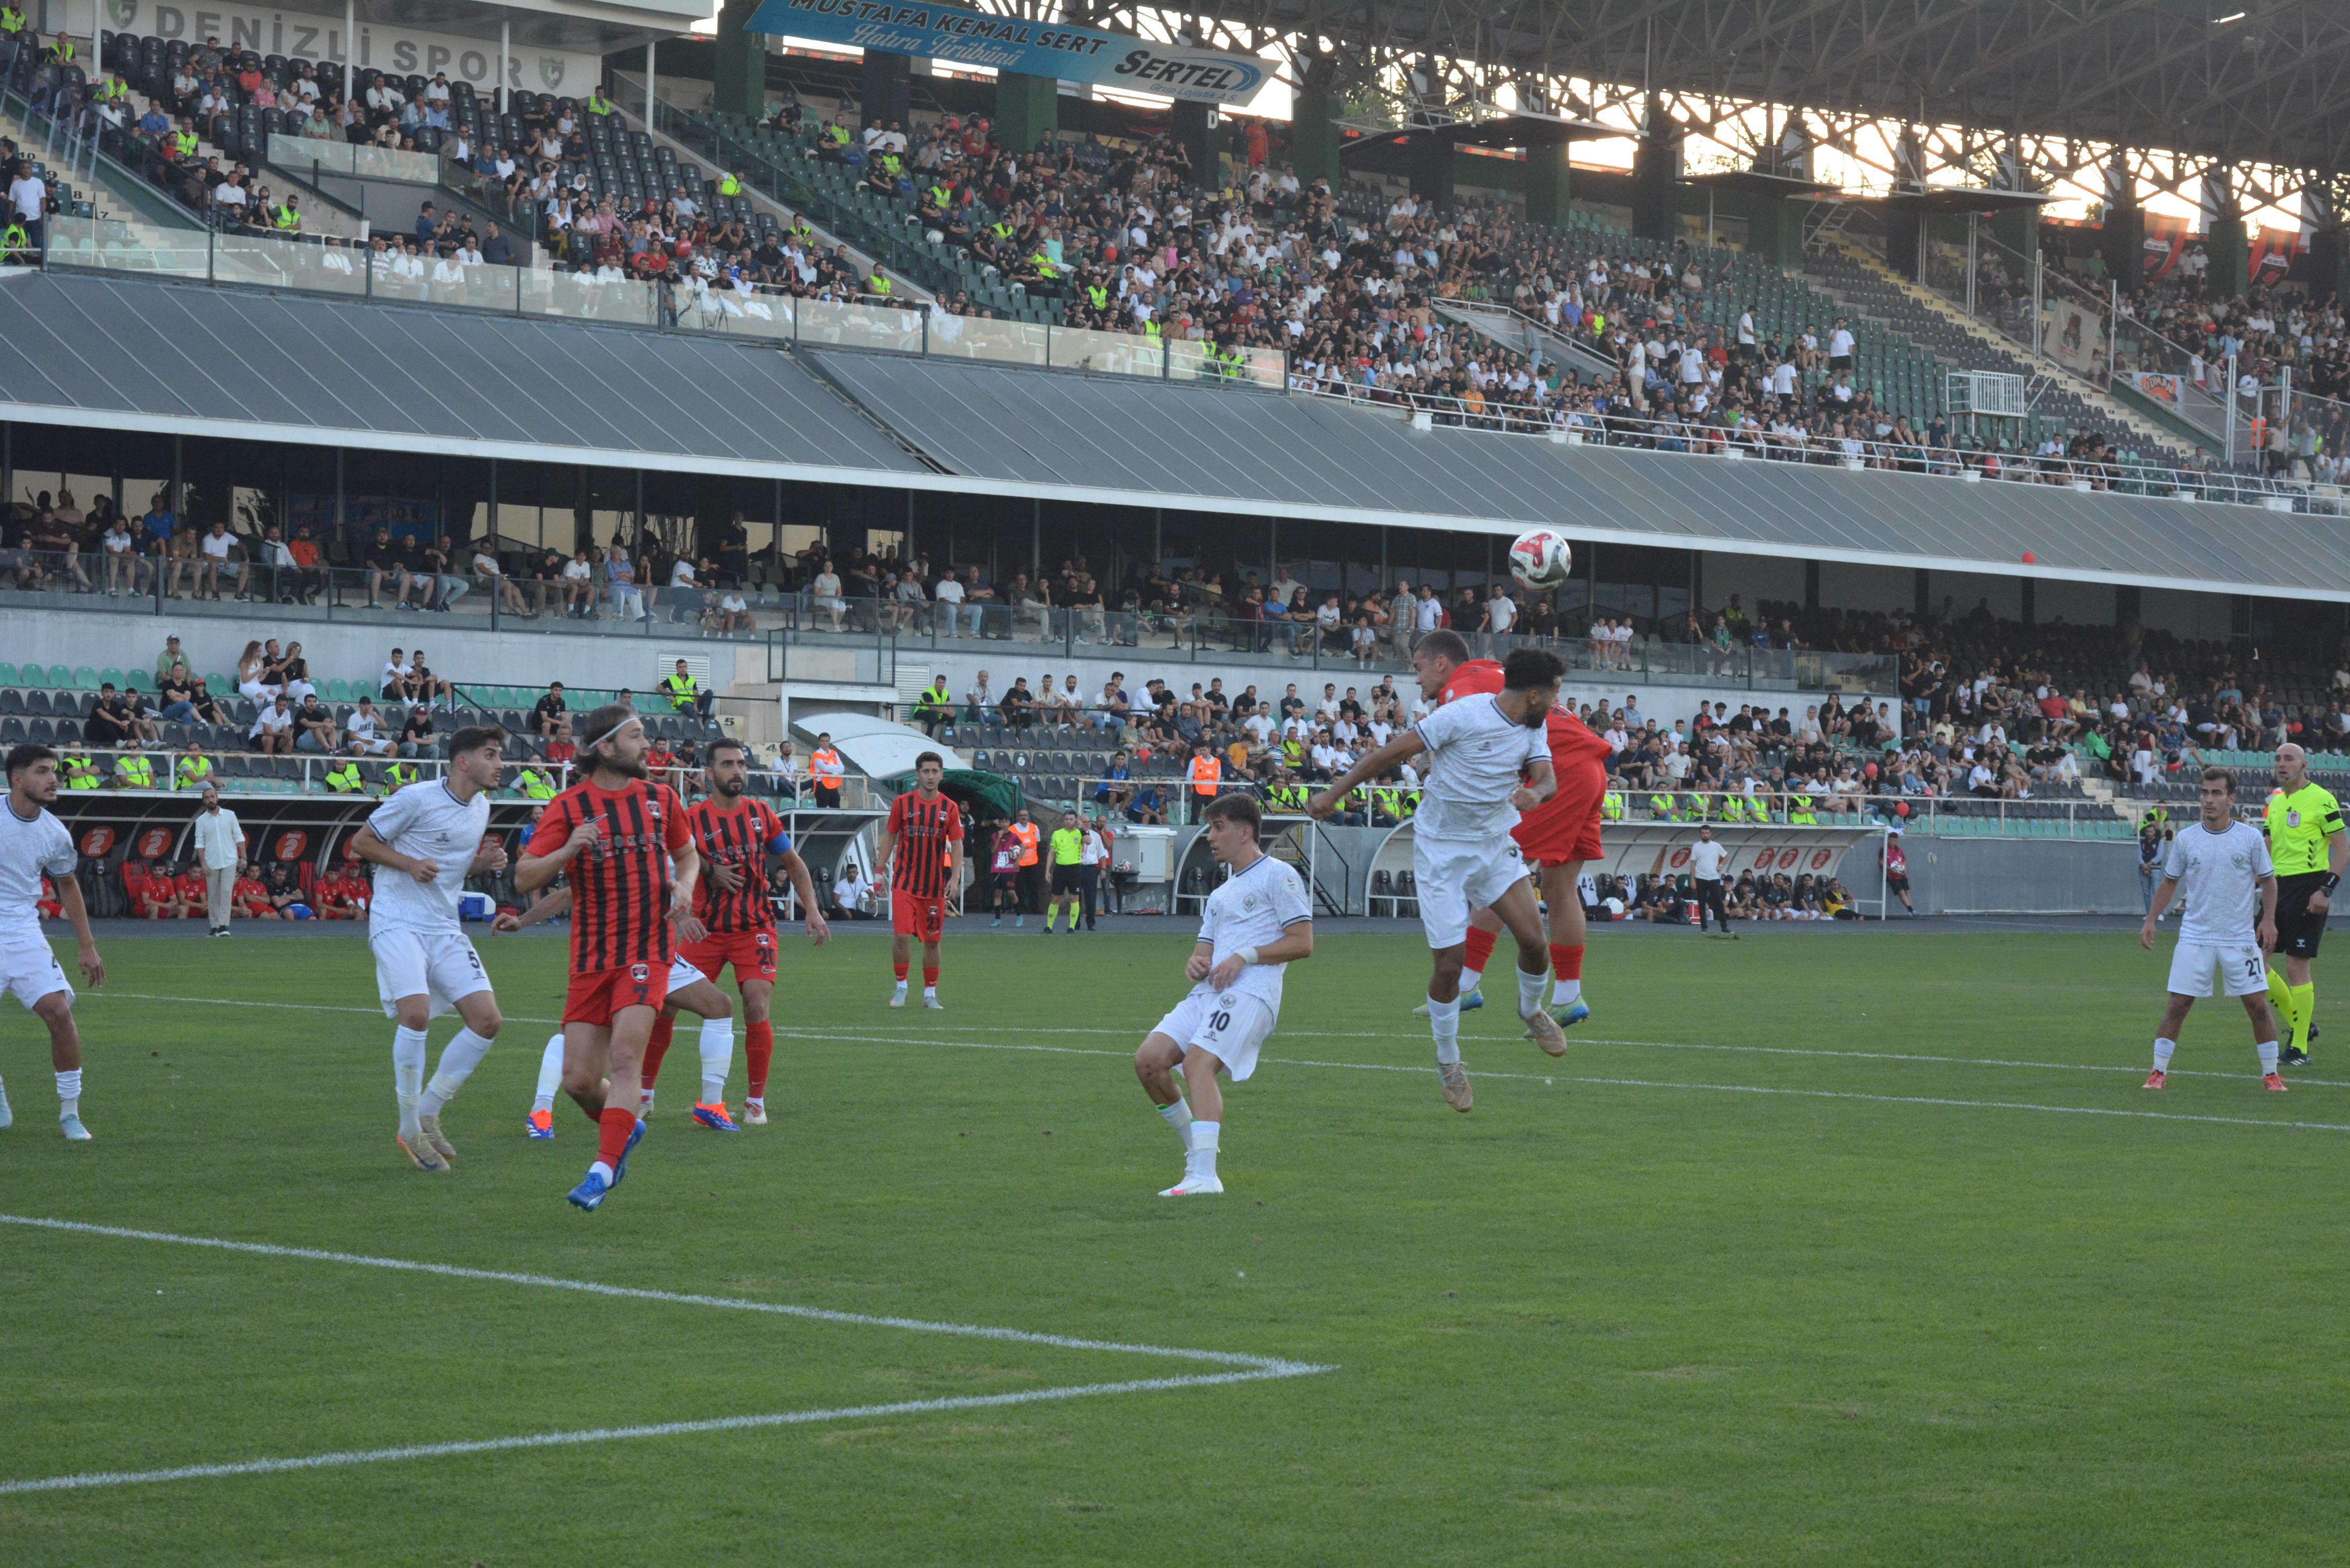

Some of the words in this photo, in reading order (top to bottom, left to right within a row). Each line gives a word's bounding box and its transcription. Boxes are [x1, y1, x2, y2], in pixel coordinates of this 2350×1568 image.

[788, 0, 929, 28] MUSTAFA
[935, 14, 1031, 44] KEMAL
[1035, 29, 1109, 55] SERT
[157, 5, 370, 66] DENİZLİ
[393, 41, 522, 88] SPOR
[1114, 50, 1235, 89] SERTEL
[1150, 83, 1176, 94] Grup
[1178, 87, 1217, 98] Lojistik
[1208, 110, 1218, 129] D
[19, 152, 36, 160] 10
[47, 170, 57, 179] 9
[73, 191, 82, 199] 8
[724, 717, 734, 726] 5
[766, 744, 777, 752] 4
[2323, 800, 2337, 812] NG
[88, 835, 105, 854] 2
[145, 836, 162, 855] 2
[282, 839, 297, 858] 2
[1582, 877, 1594, 891] 42
[926, 917, 940, 930] 21
[468, 951, 479, 969] 5
[756, 948, 776, 967] 20
[2245, 958, 2261, 977] 27
[633, 985, 648, 1004] 7
[1208, 1010, 1230, 1031] 10
